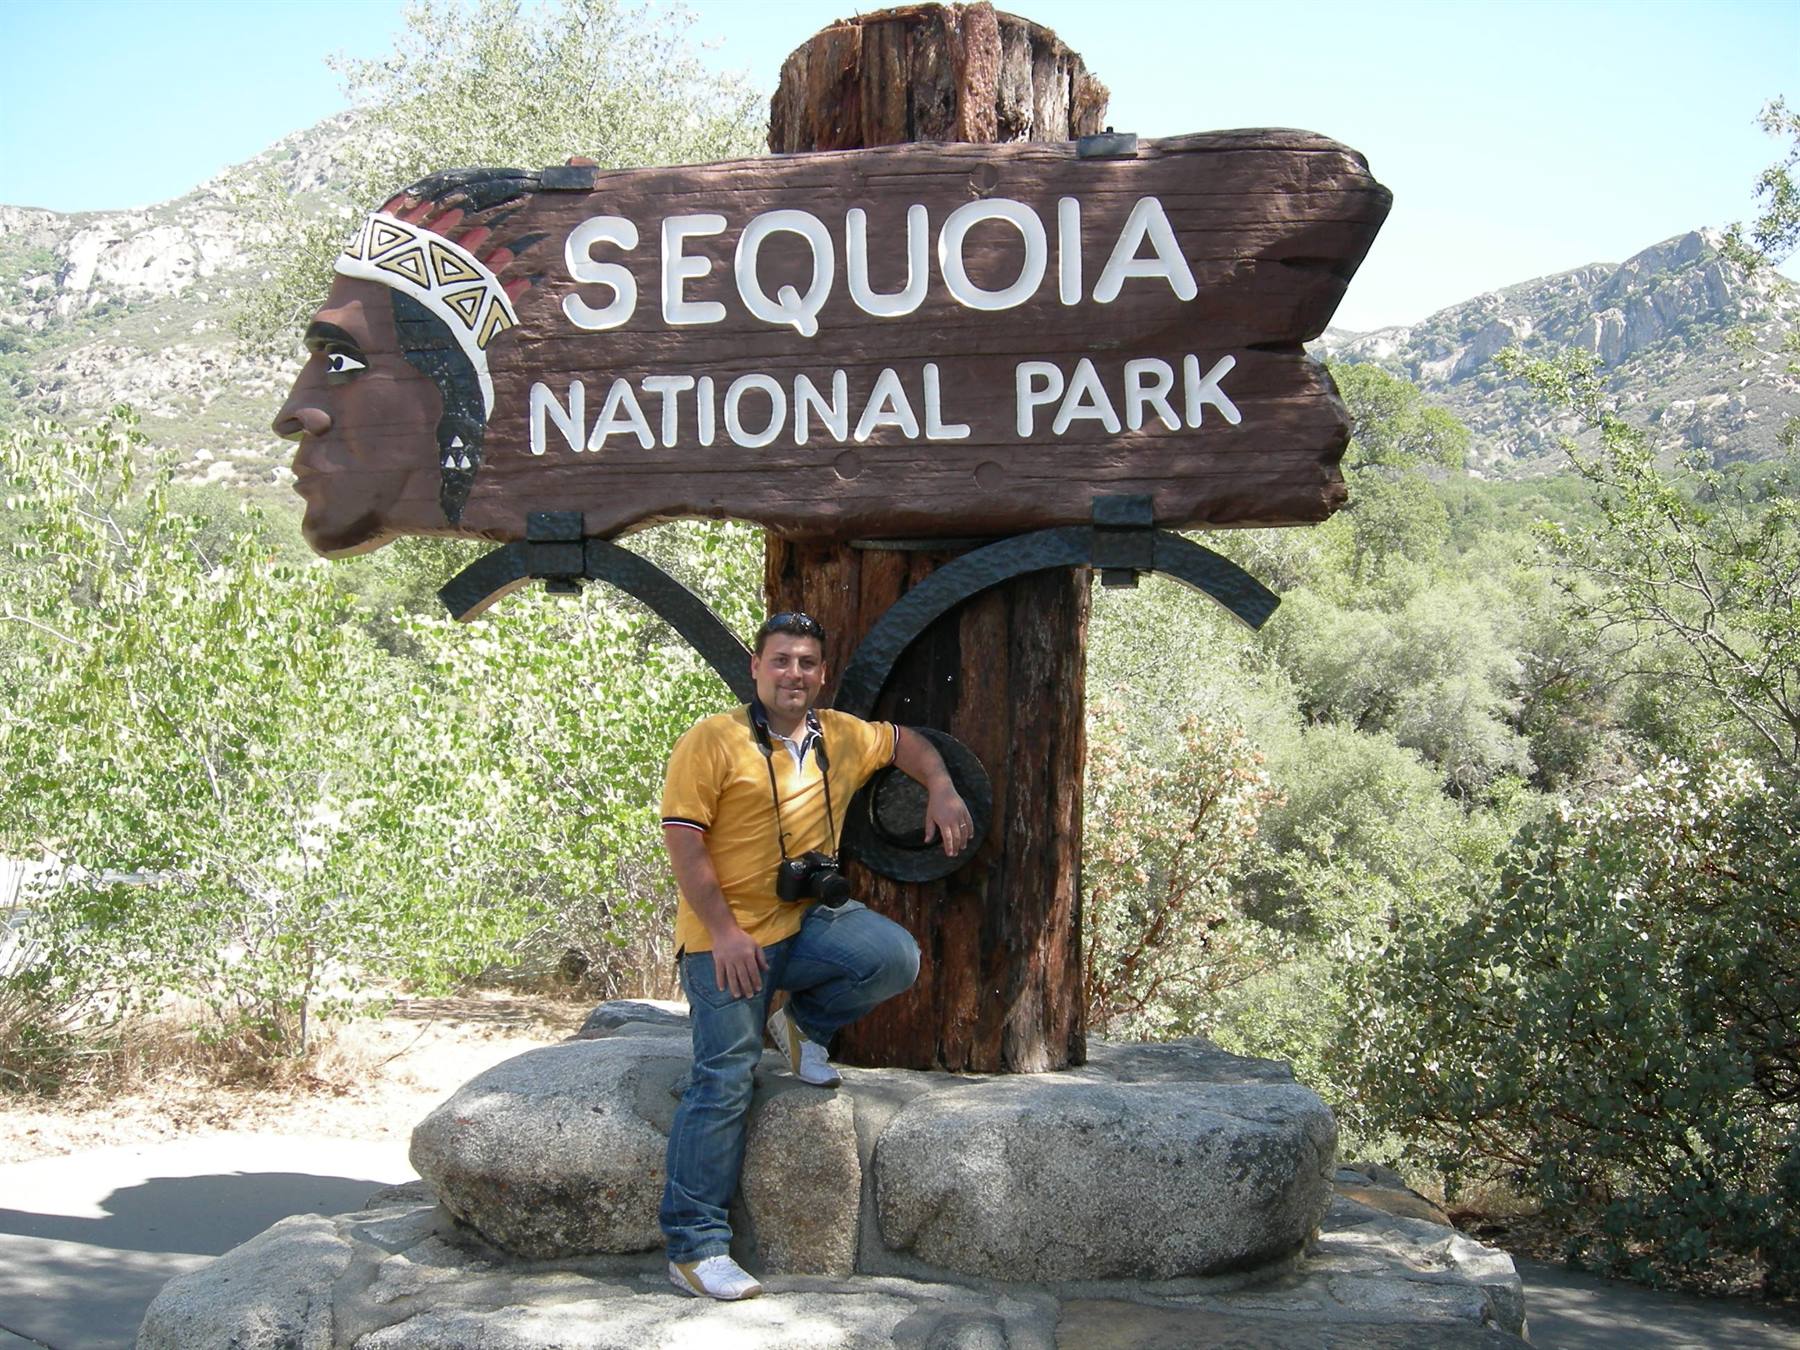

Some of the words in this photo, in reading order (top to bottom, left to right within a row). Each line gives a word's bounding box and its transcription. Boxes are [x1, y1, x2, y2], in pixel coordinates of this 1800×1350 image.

[561, 196, 1198, 337] SEQUOIA
[529, 362, 971, 456] NATIONAL
[1016, 354, 1242, 438] PARK
